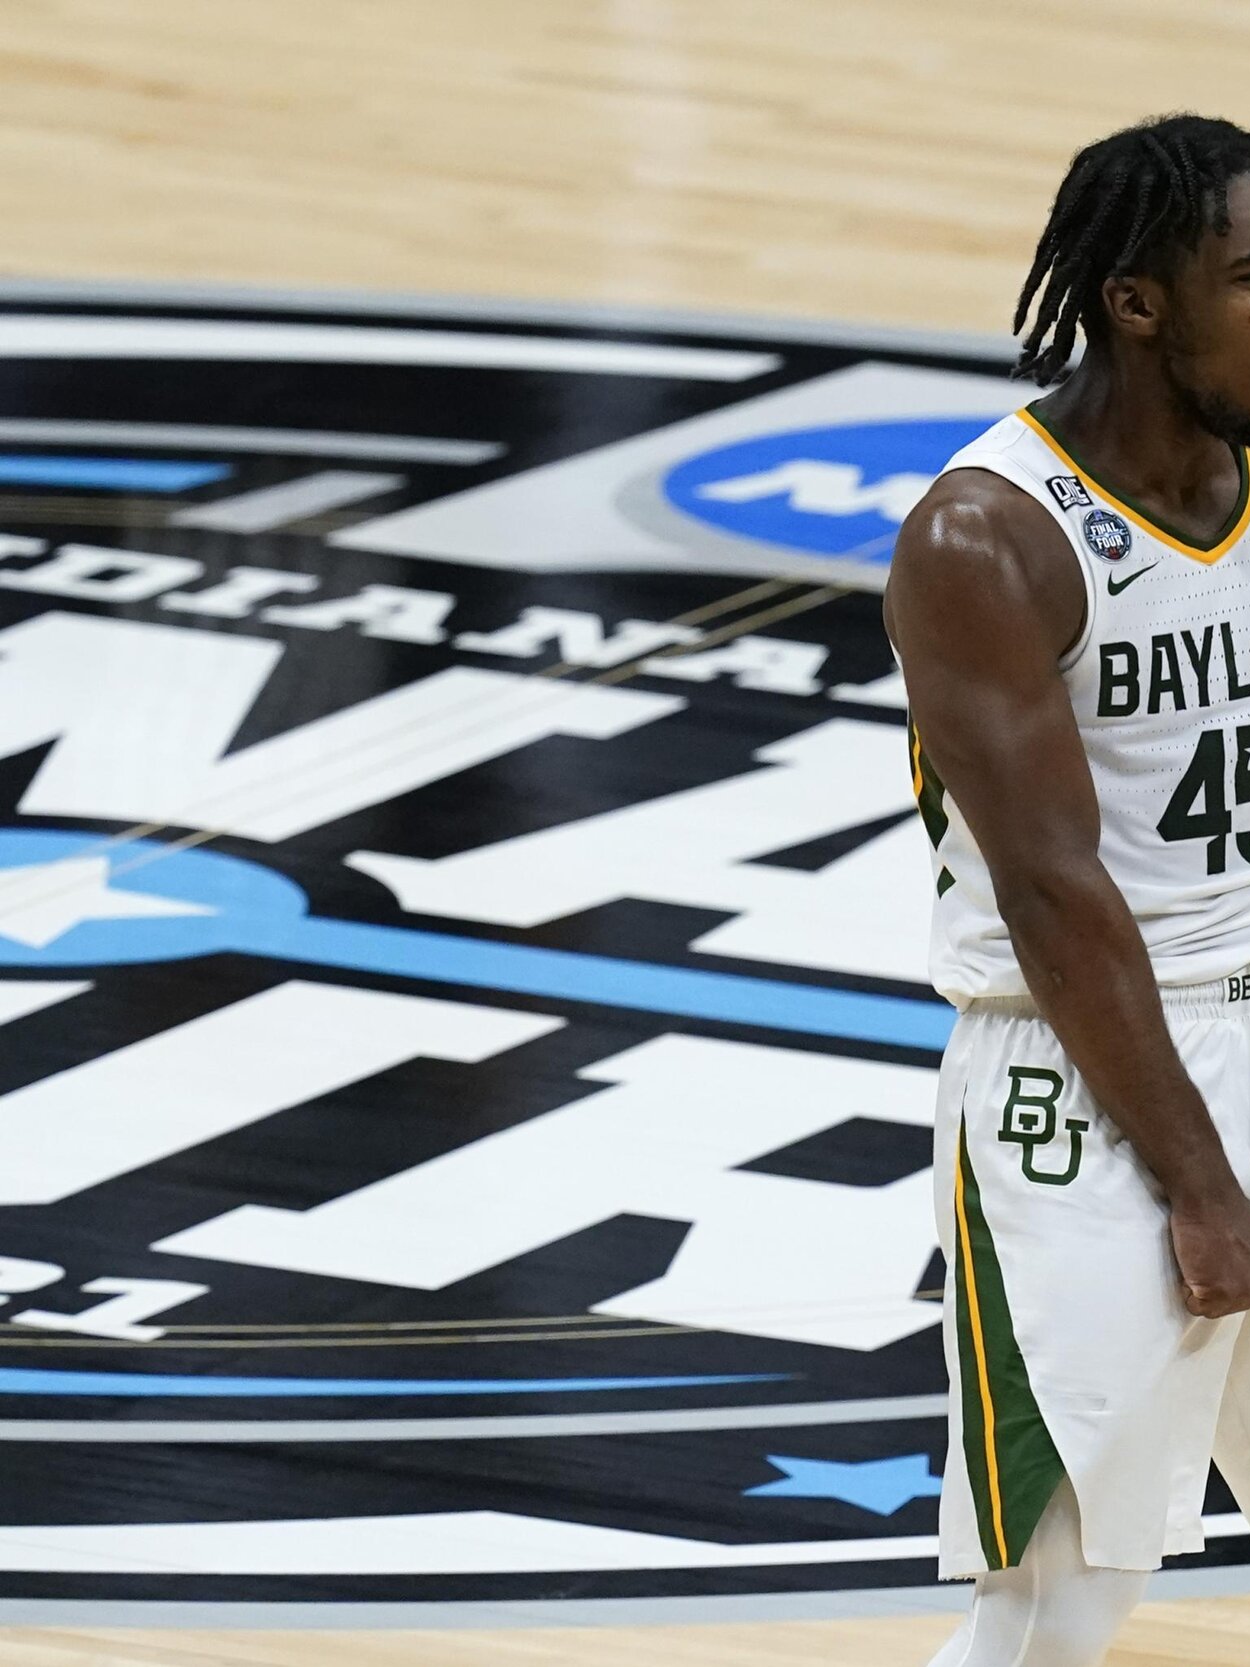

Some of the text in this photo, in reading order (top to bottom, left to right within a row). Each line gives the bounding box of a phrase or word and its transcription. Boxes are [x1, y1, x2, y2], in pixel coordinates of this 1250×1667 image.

[1090, 522, 1118, 535] FINAL
[1096, 534, 1124, 550] FOUR
[998, 1065, 1089, 1186] BU
